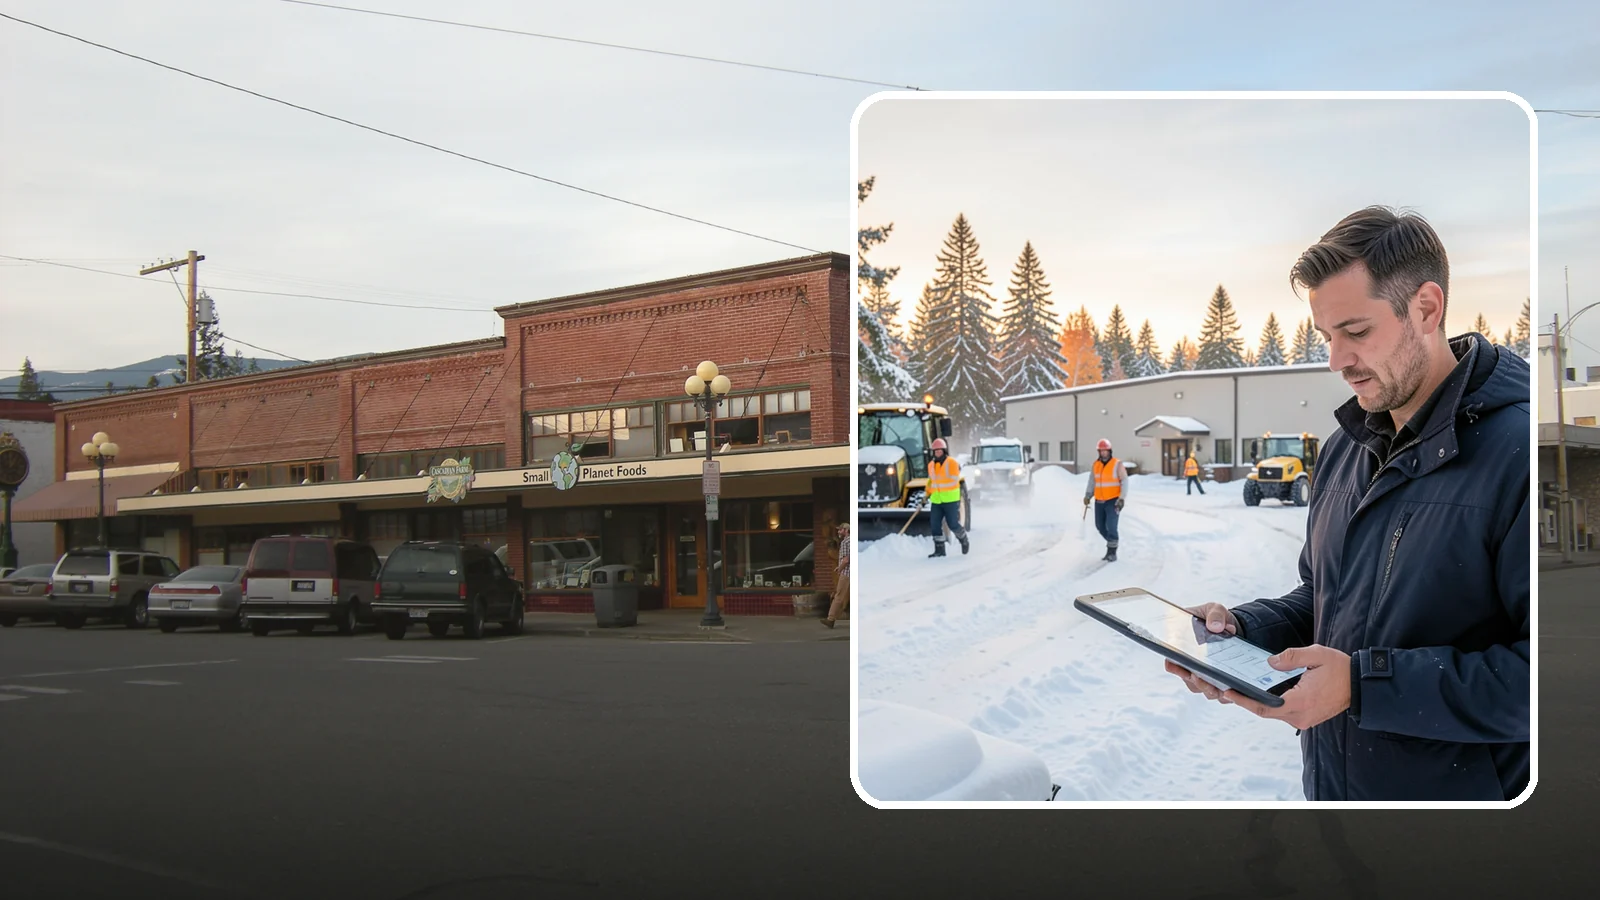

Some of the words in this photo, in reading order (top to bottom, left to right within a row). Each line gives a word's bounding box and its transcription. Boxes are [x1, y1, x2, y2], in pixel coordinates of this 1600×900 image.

[523, 470, 549, 482] Small
[583, 467, 614, 479] Planet
[617, 464, 647, 476] Foods
